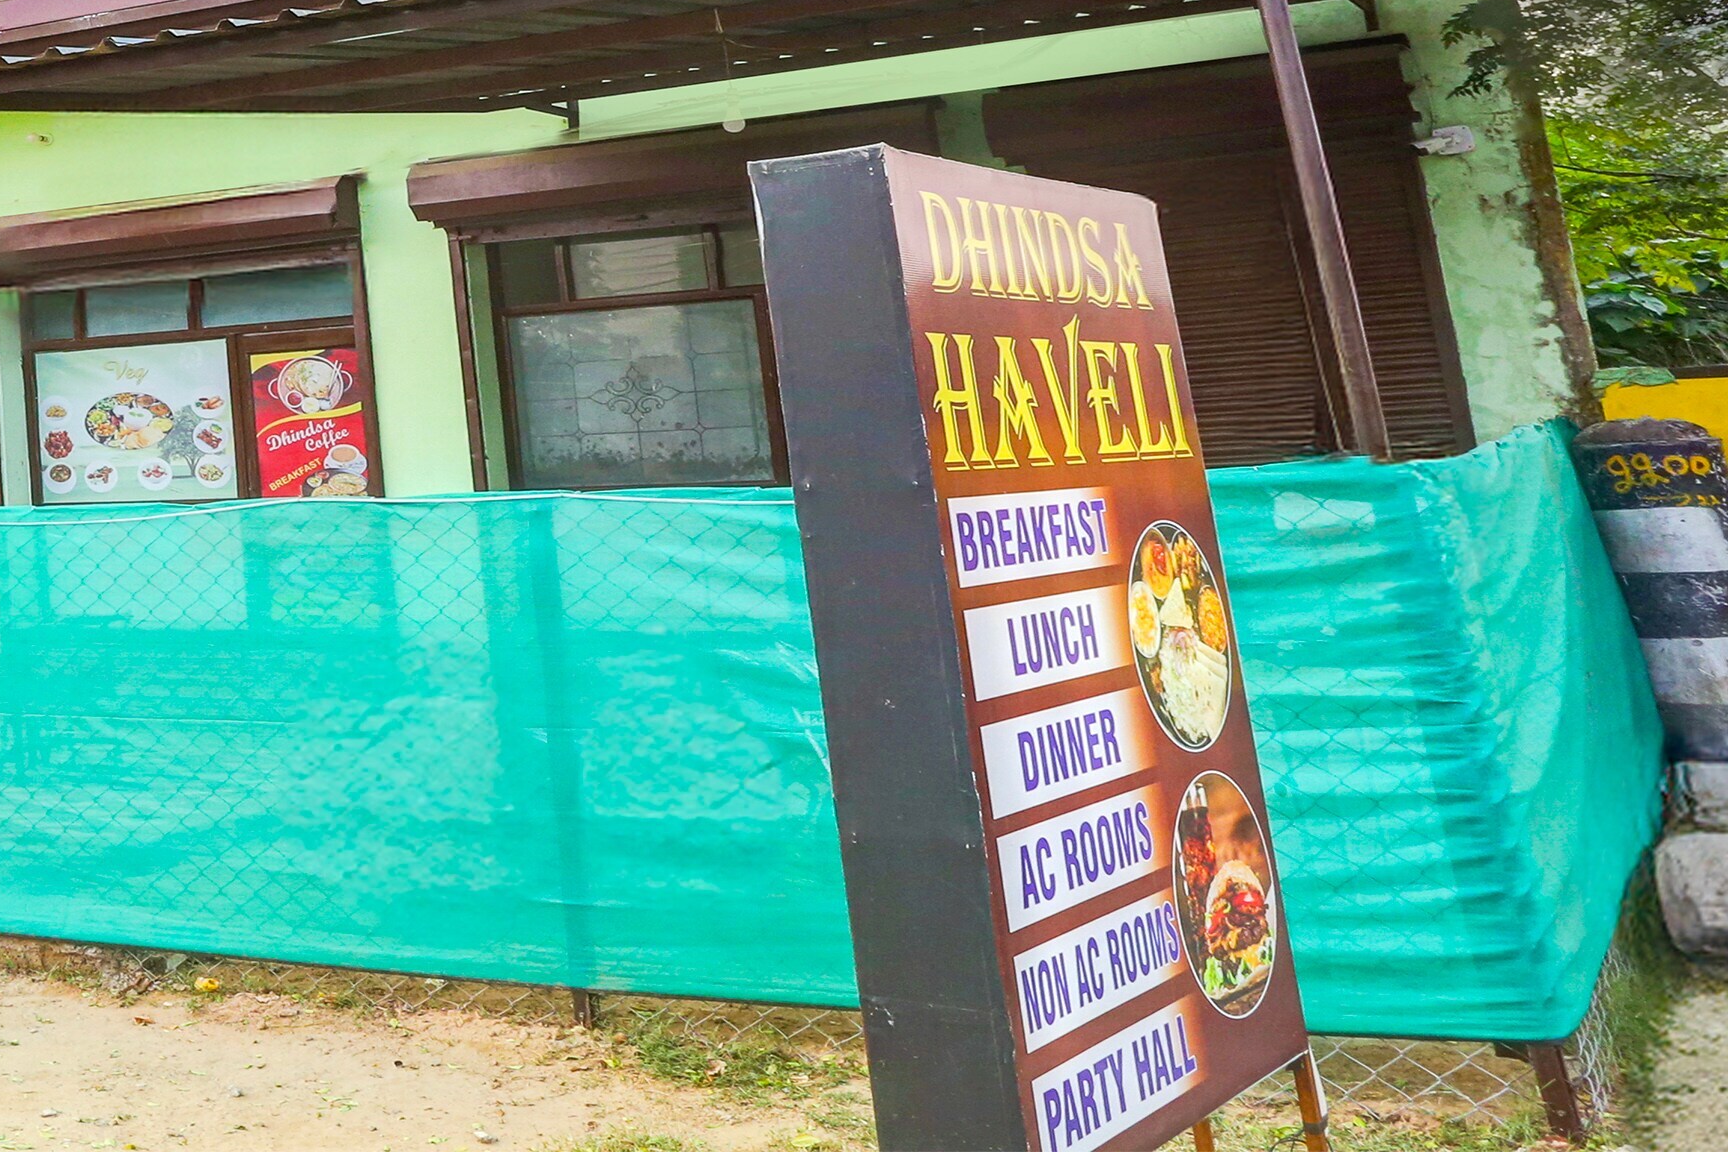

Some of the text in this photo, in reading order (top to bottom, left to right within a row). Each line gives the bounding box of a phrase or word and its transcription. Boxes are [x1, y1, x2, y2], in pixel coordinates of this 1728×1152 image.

[918, 190, 1154, 312] DHINDSA
[265, 418, 336, 452] Dhindsa
[925, 314, 1194, 472] HAVELI
[268, 457, 323, 492] BREAKFAST
[304, 428, 350, 452] Coffee
[955, 498, 1109, 574] BREAKFAST
[1006, 603, 1101, 678] LUNCH
[1016, 708, 1122, 793] DINNER
[1018, 801, 1155, 910] AC ROOMS
[1019, 900, 1182, 1035] NON AC ROOMS
[1042, 1013, 1197, 1152] PARTY HALL
